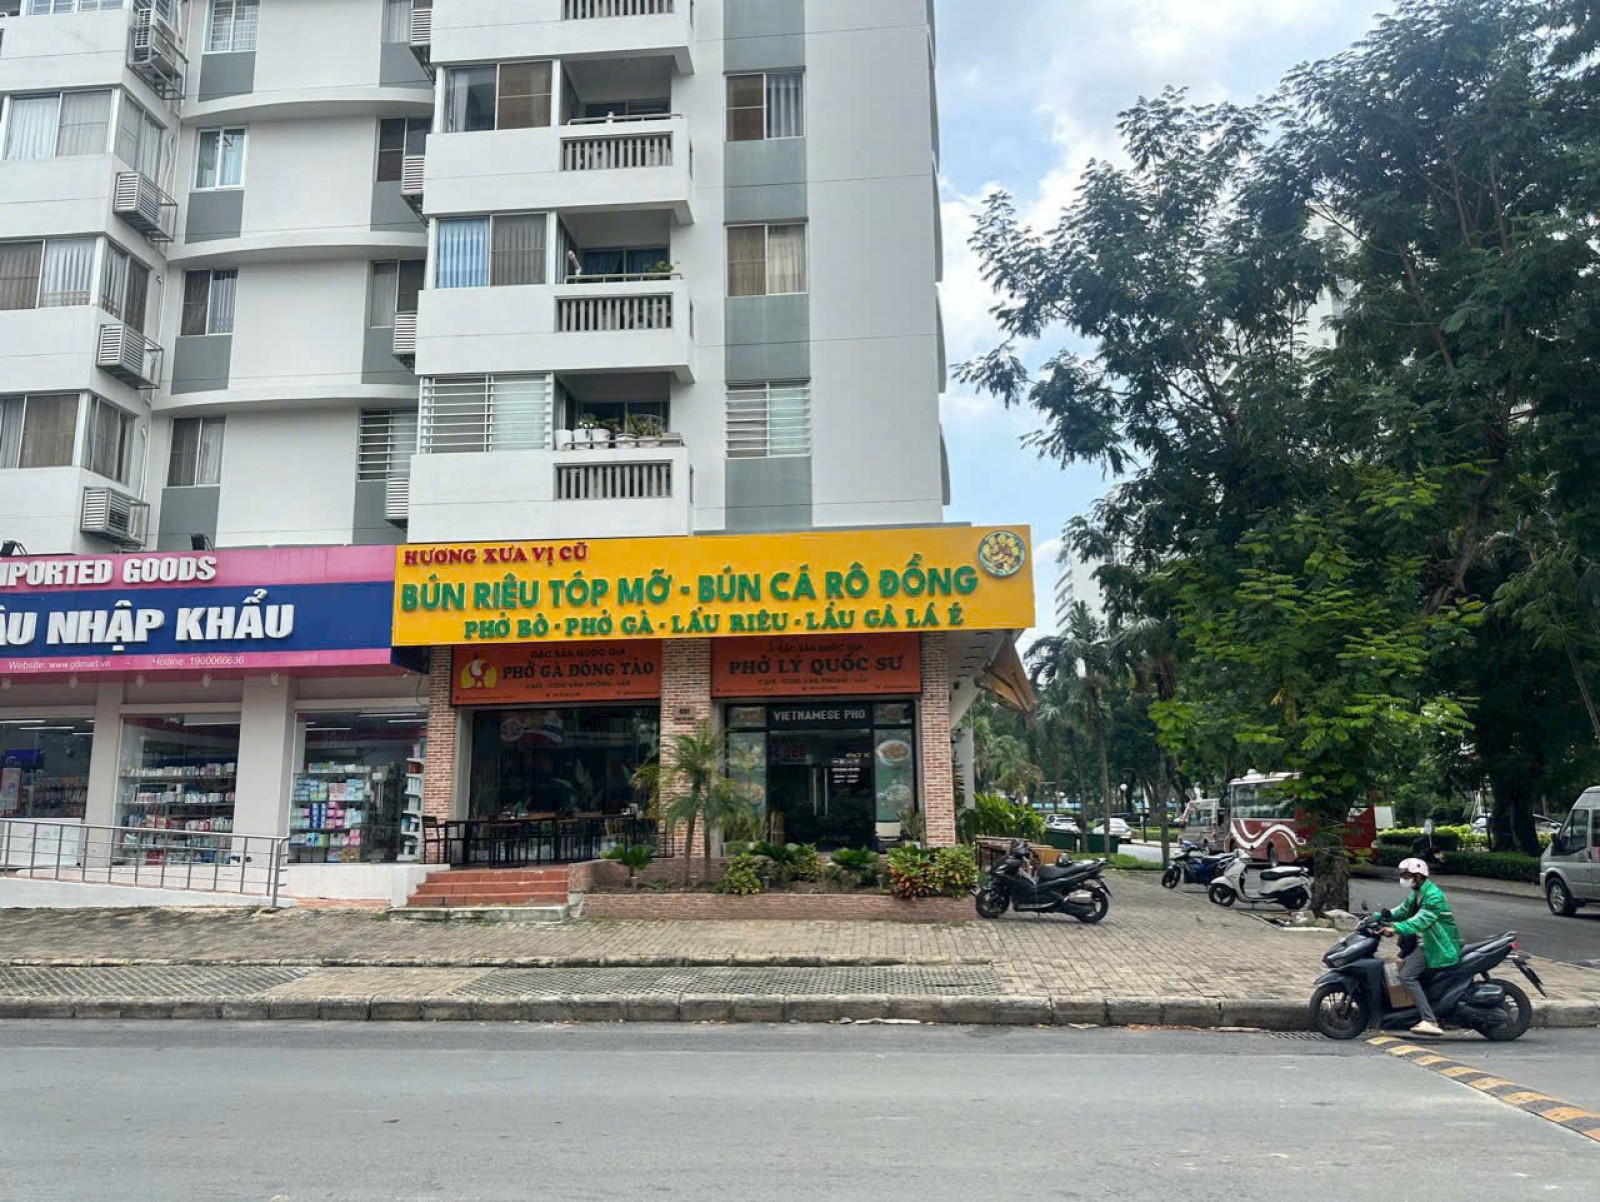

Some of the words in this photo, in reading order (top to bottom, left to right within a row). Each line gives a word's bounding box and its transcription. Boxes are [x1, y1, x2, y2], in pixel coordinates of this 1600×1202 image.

[404, 547, 476, 566] HƯƠNG
[483, 544, 527, 564] XƯA
[532, 546, 554, 566] VỊ
[560, 541, 588, 561] CŨ
[123, 556, 217, 584] GOODS
[401, 573, 465, 611] BÚN
[473, 572, 540, 609] RIÊU
[548, 570, 609, 606] TÓP
[617, 568, 673, 605] MỠ
[699, 566, 761, 602] BÚN
[770, 563, 816, 600] CÁ
[825, 561, 870, 599] RÔ
[879, 553, 979, 598] ĐỒNG
[46, 600, 164, 651] NHẬP
[175, 588, 295, 641] KHẨU
[464, 612, 511, 640] PHỞ
[517, 612, 549, 637] BÒ
[565, 609, 613, 636] PHỞ
[621, 609, 655, 635] GÀ
[671, 606, 720, 633] LẨU
[730, 609, 789, 632] RIÊU
[806, 601, 855, 630] LẨU
[864, 603, 898, 628] GÀ
[906, 602, 940, 628] LÁ
[729, 655, 770, 675] PHỞ
[810, 652, 869, 675] QUỐC
[774, 709, 840, 722] VIETNAMESE
